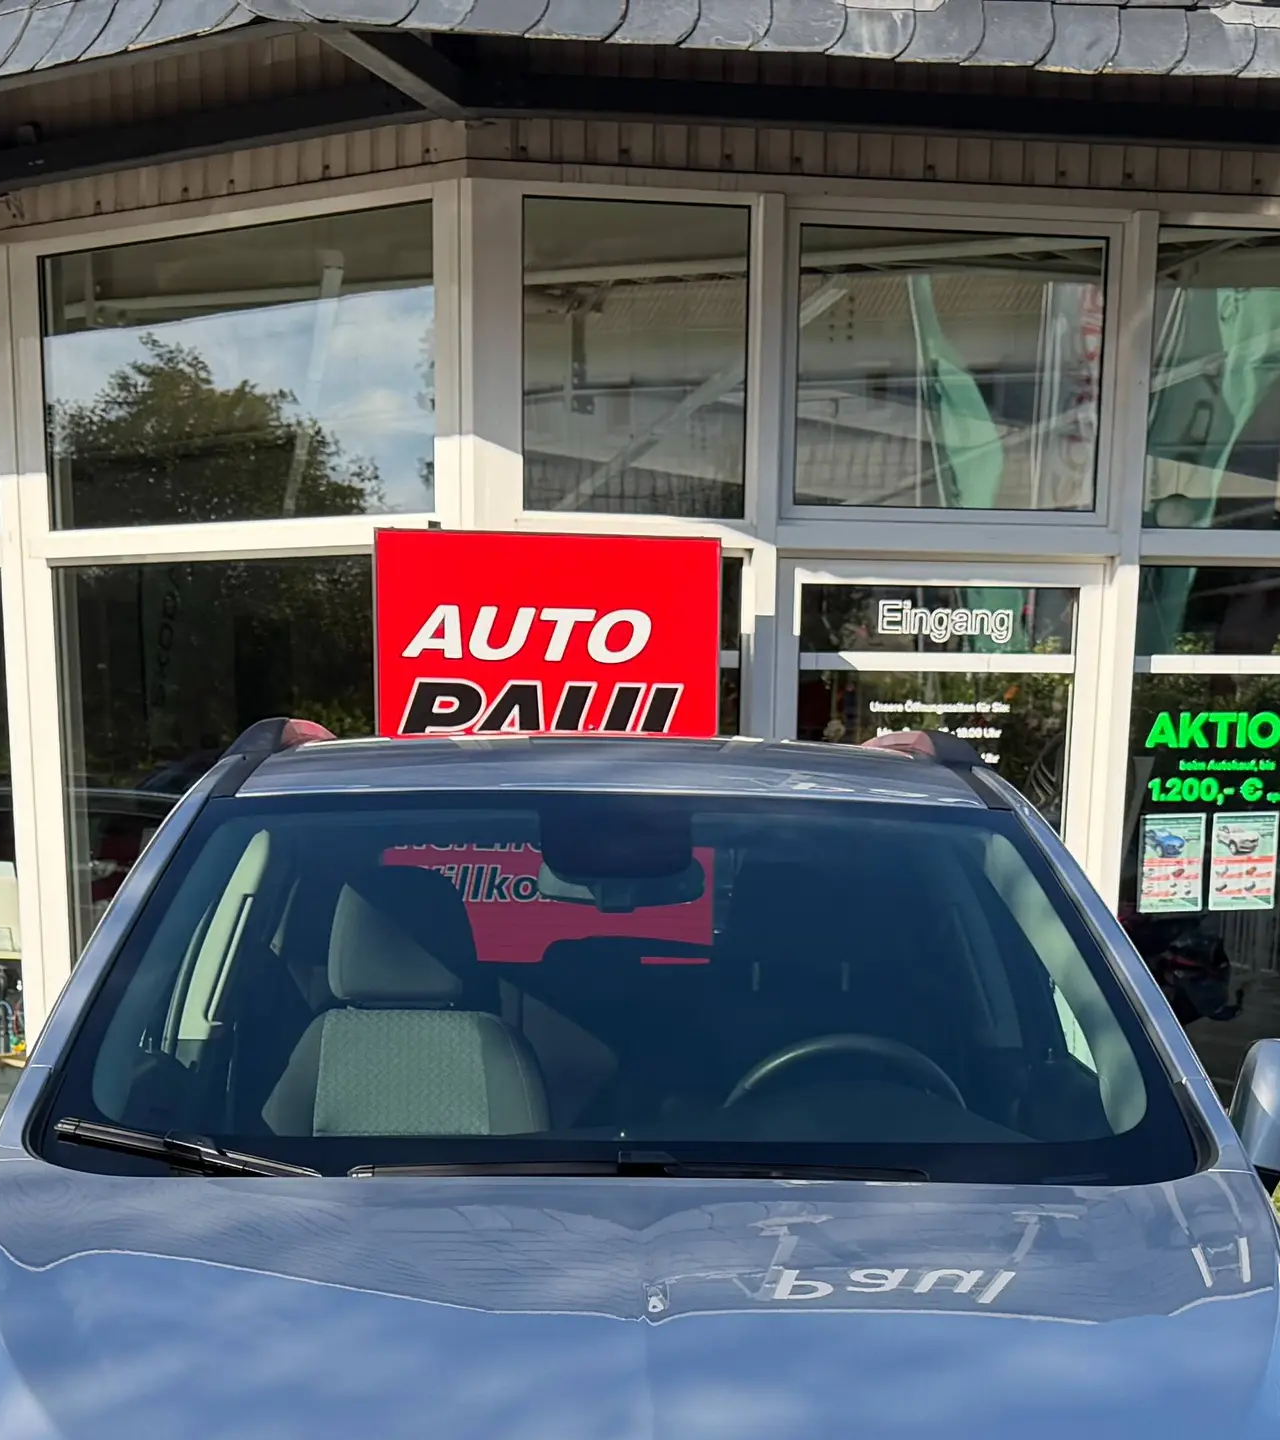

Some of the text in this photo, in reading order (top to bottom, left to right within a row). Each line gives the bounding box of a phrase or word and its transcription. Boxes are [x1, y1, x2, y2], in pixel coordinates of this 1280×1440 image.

[401, 604, 652, 664] AUTO
[878, 599, 1013, 643] Eingang
[1148, 777, 1235, 806] 1.200,-
[1240, 777, 1264, 802] €
